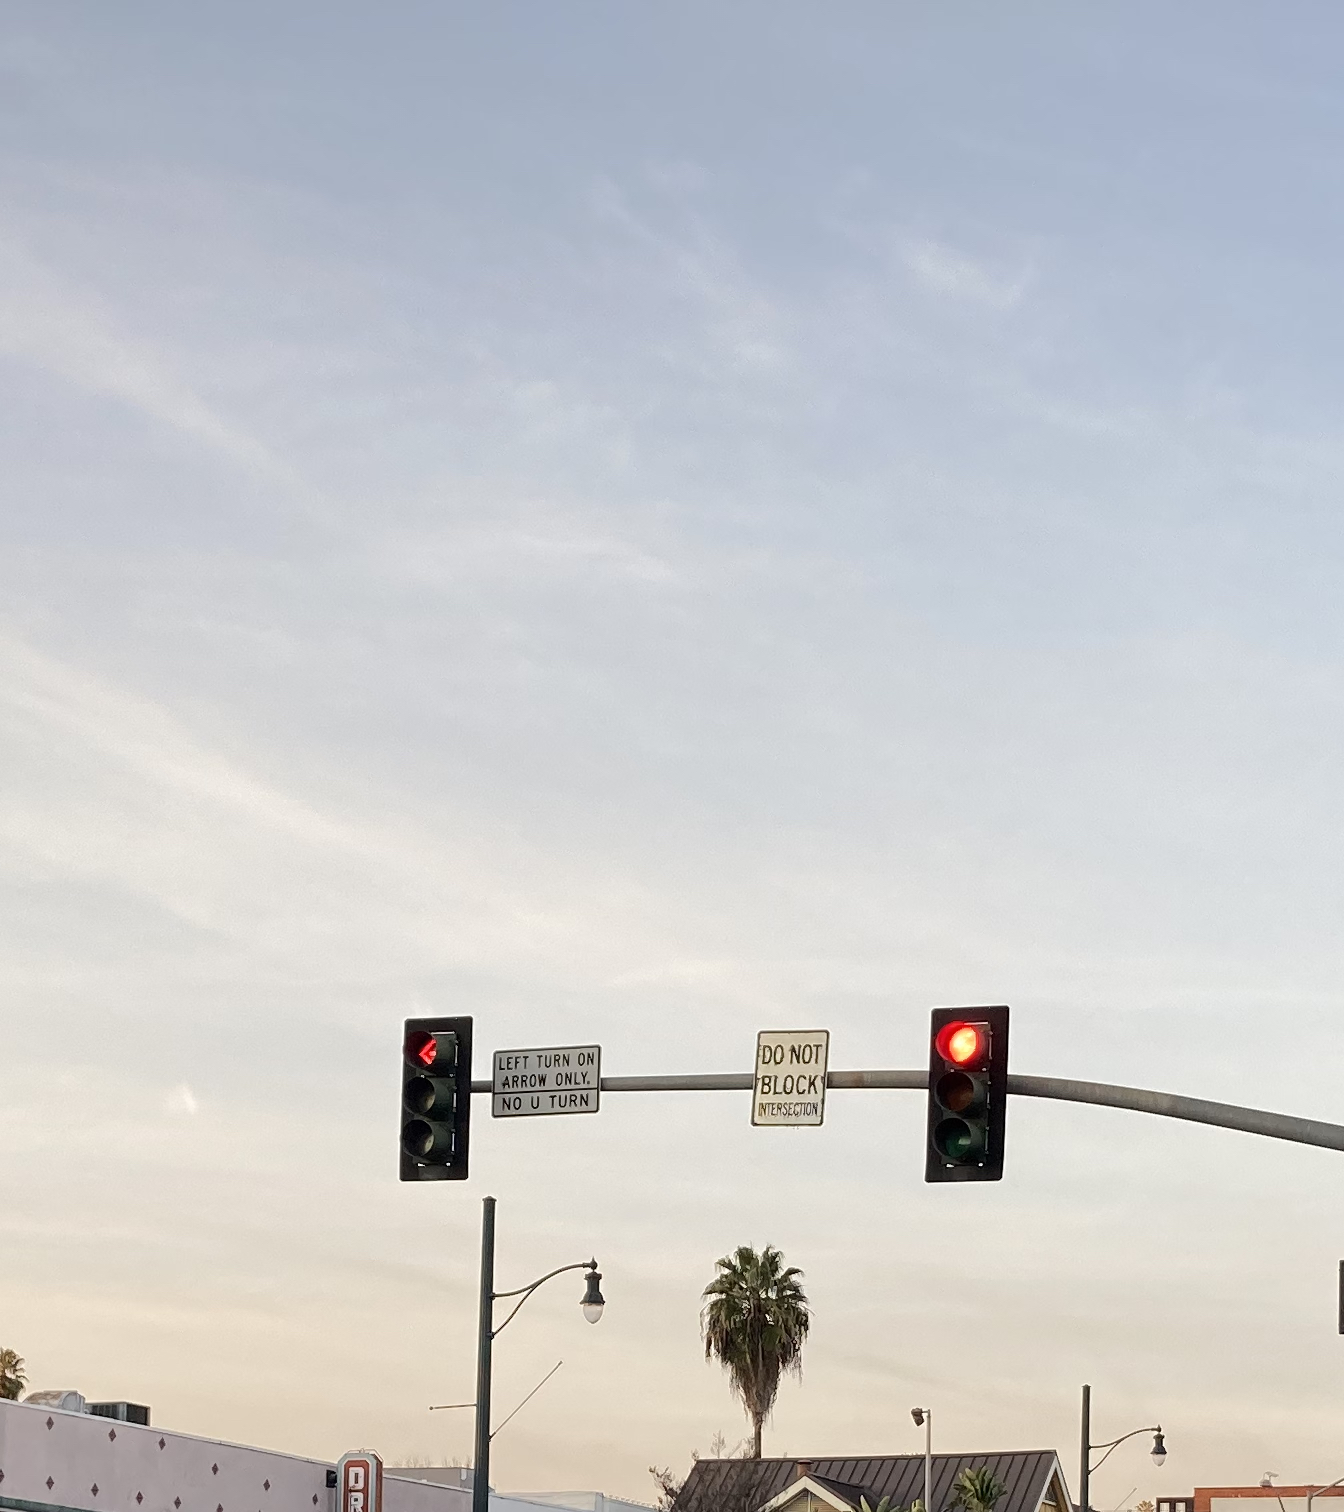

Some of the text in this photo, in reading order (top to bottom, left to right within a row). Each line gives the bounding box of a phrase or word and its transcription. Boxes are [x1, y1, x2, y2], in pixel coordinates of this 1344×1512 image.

[499, 1052, 594, 1070] LEFT TURN ON
[761, 1044, 822, 1065] DO NOT
[502, 1071, 590, 1089] ARROW ONLY.
[761, 1075, 819, 1095] BLOCK
[502, 1093, 589, 1111] NO U TURN
[758, 1102, 819, 1117] INTERSECTION
